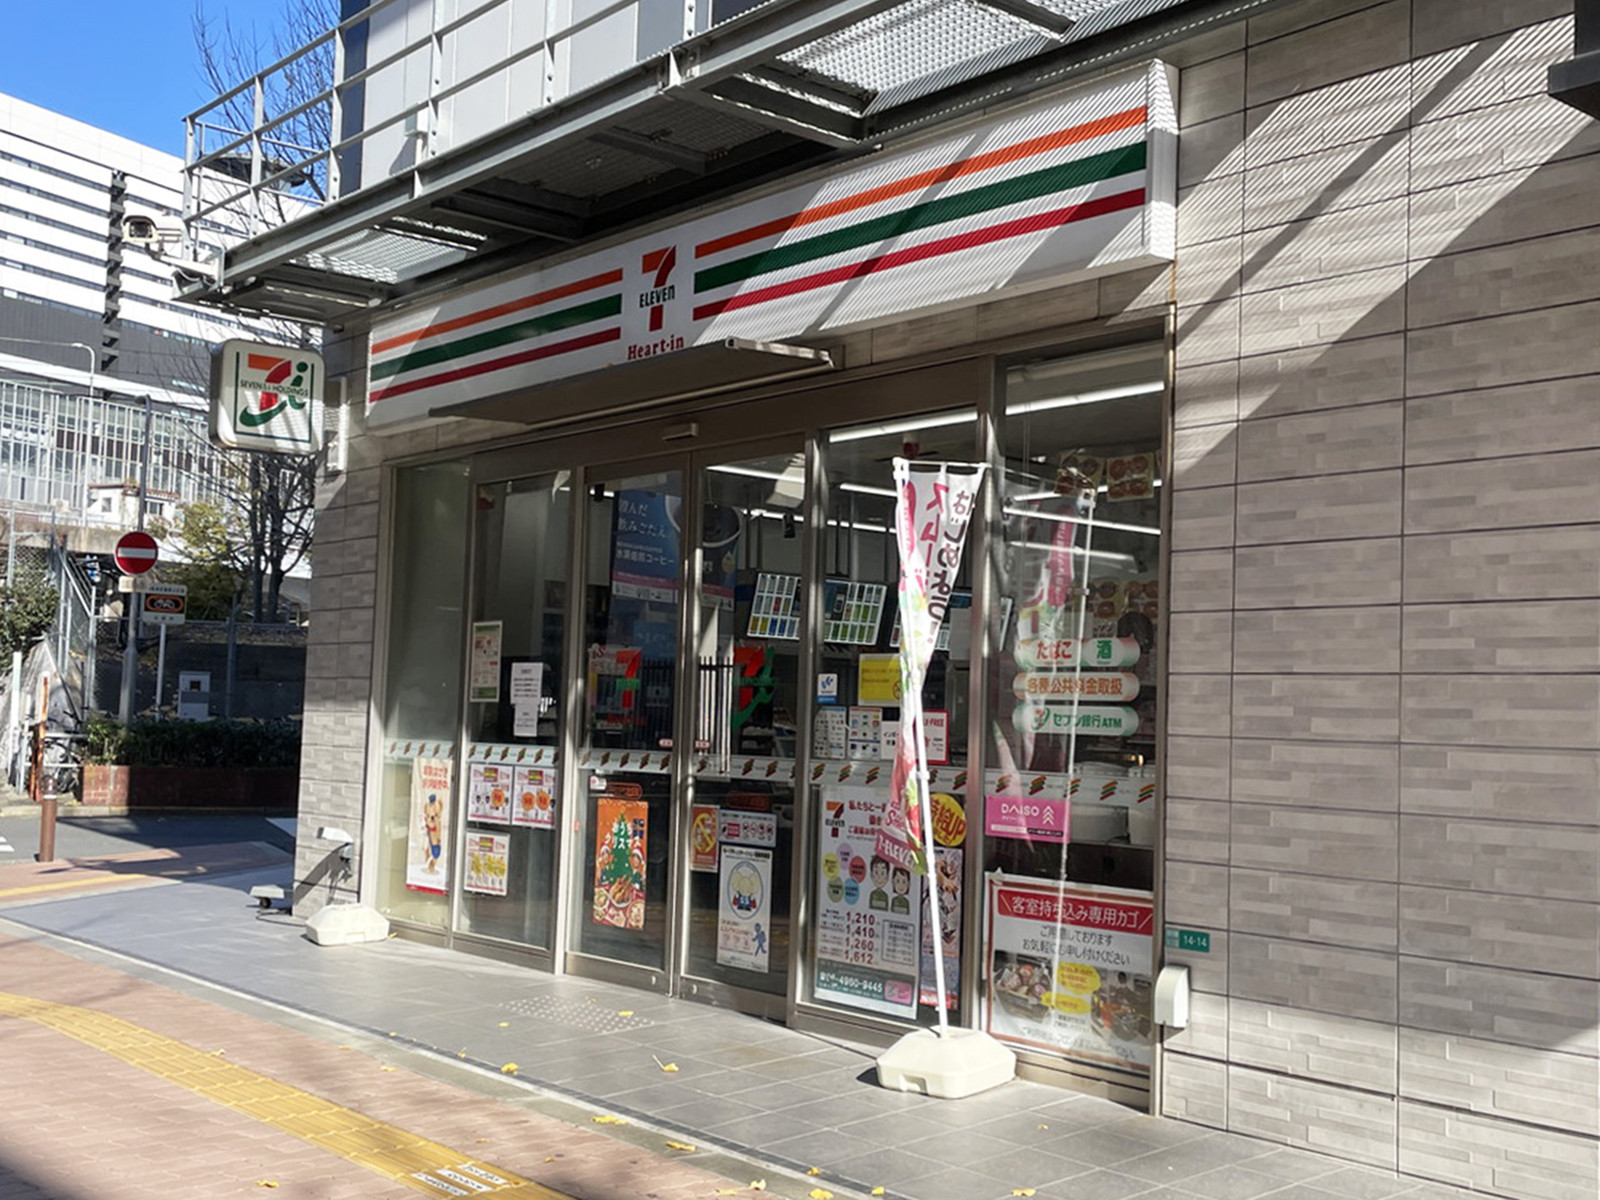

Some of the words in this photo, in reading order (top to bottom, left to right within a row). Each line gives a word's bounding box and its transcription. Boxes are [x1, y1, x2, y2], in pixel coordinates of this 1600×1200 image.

[1036, 640, 1073, 660] たばこ
[1096, 639, 1112, 660] 酒
[1000, 803, 1040, 817] DAISO
[604, 832, 642, 850] クリスマス
[1011, 896, 1140, 929] 客室持ち込み専用カゴ
